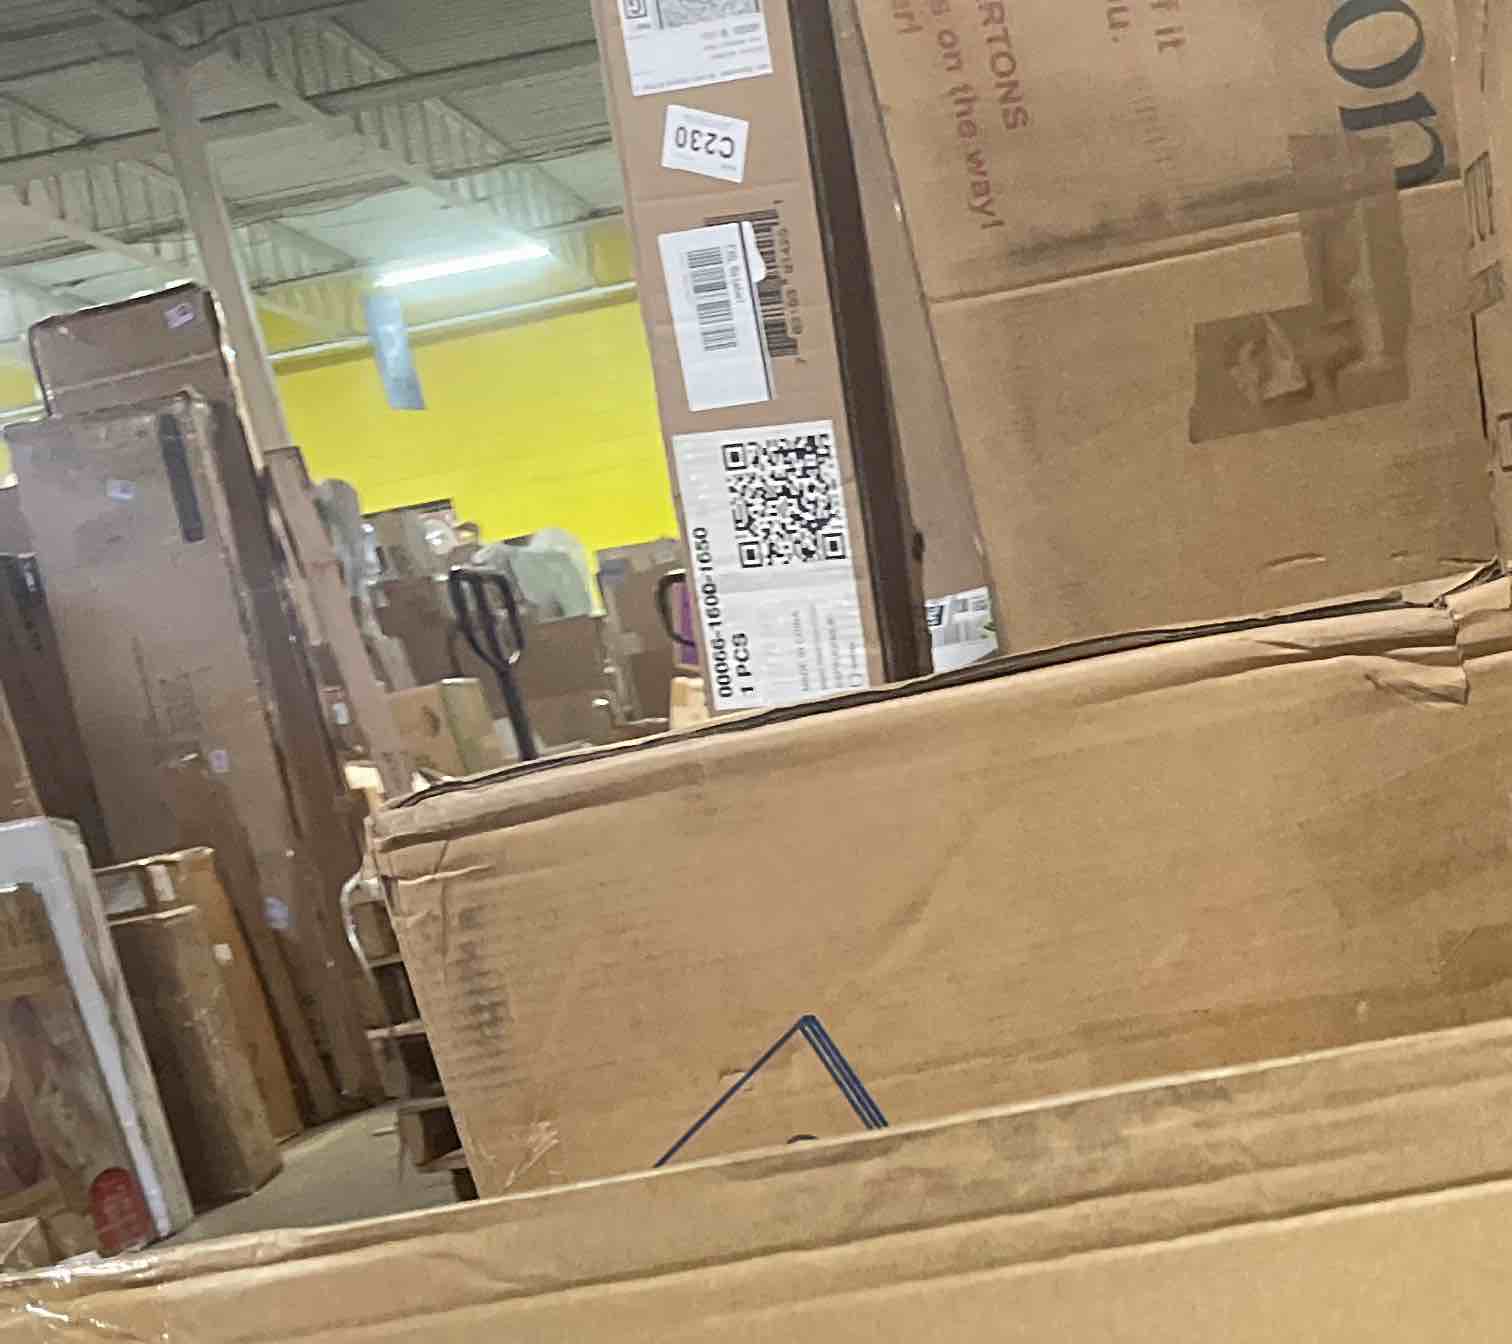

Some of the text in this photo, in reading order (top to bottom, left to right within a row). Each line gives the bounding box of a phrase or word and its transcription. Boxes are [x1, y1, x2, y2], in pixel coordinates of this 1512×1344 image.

[937, 29, 964, 72] on
[976, 0, 1029, 130] RTONS
[946, 82, 979, 138] the
[674, 125, 735, 159] C230
[732, 632, 753, 677] PCS
